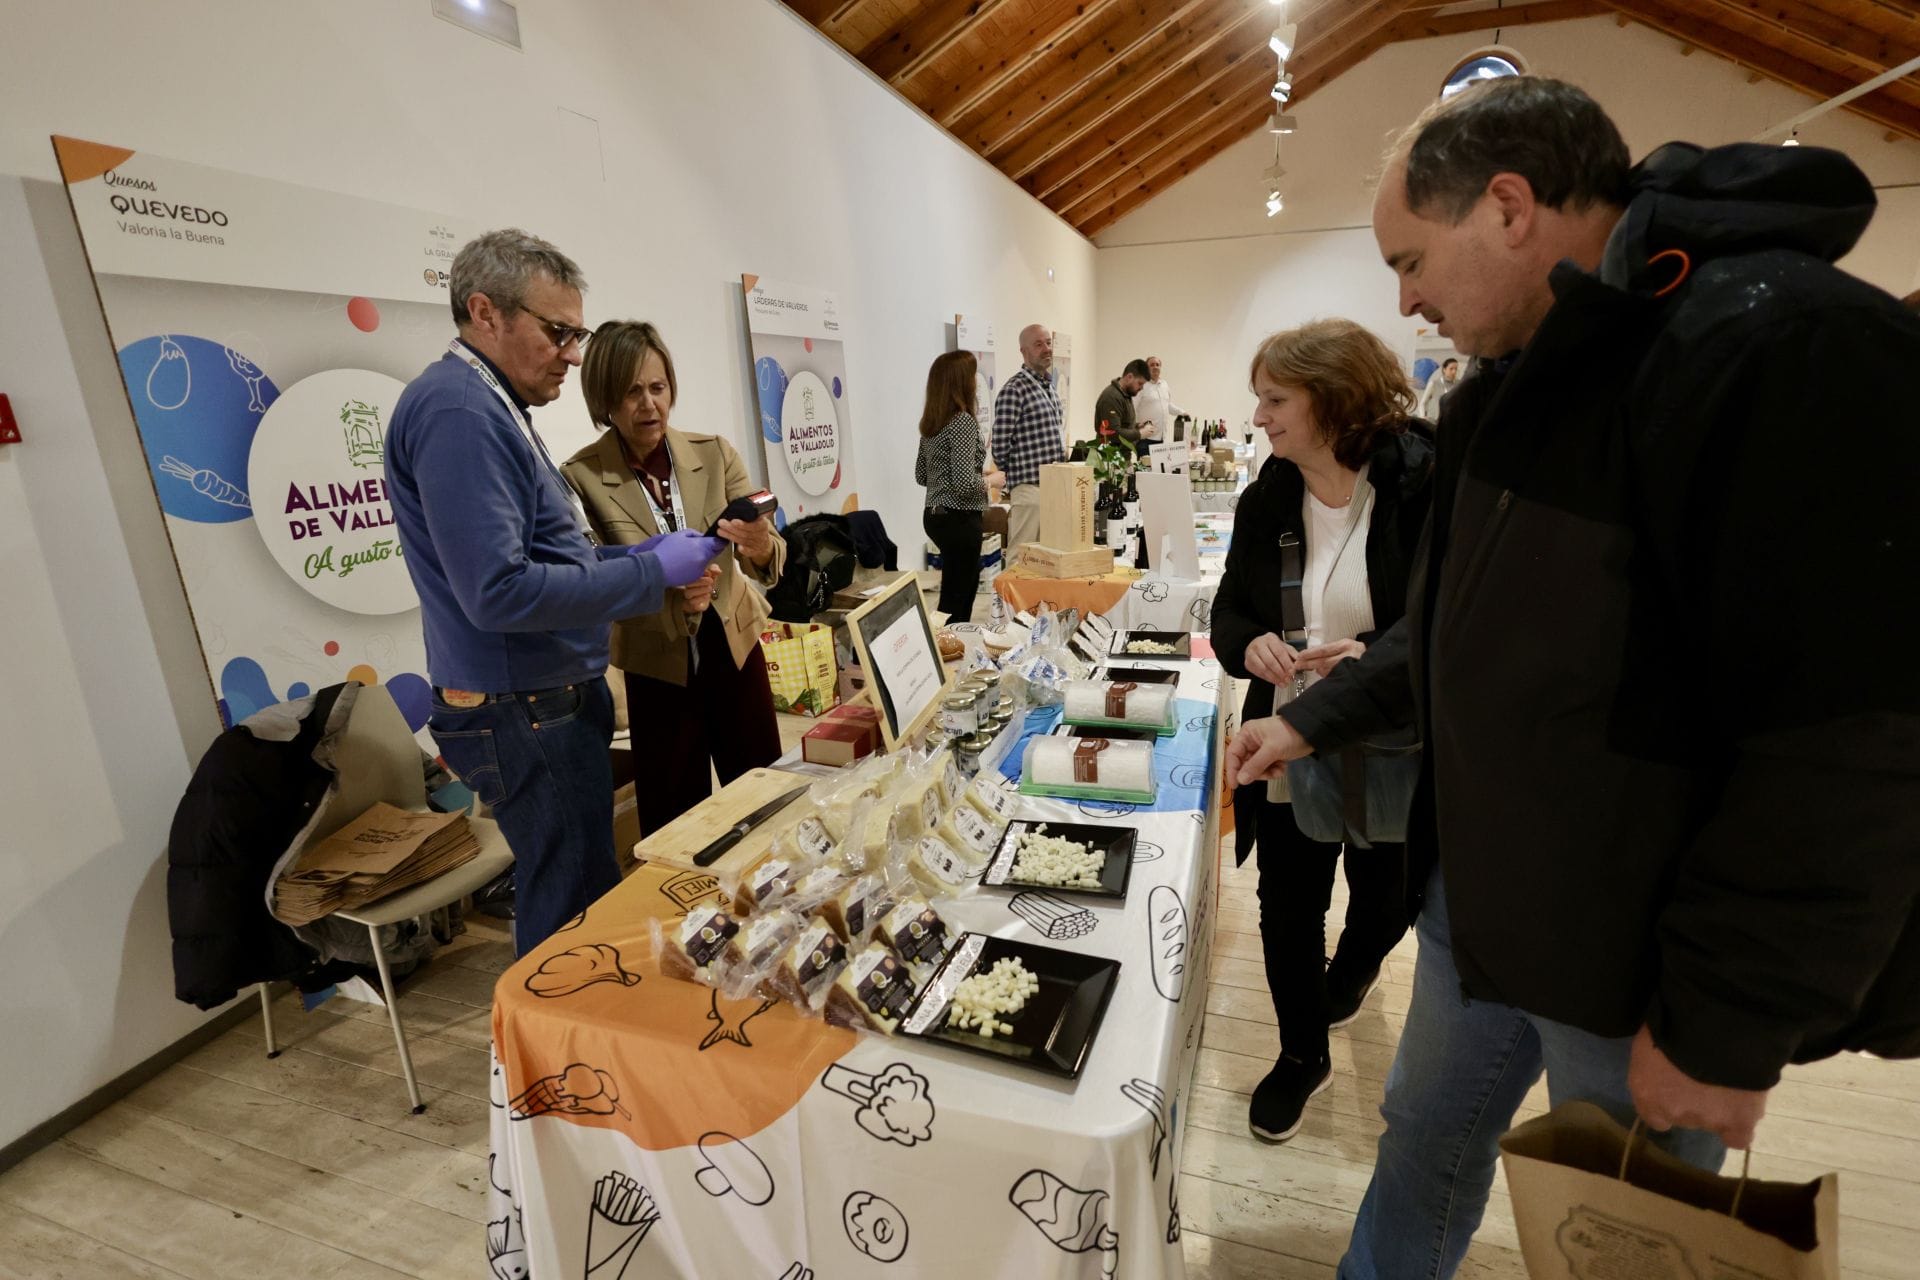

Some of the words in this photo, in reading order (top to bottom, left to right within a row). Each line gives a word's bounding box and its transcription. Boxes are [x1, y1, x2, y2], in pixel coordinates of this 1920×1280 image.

[103, 169, 157, 192] Quesos
[110, 194, 229, 227] QUEVEDO
[117, 220, 167, 238] Valoria
[170, 228, 182, 240] la
[185, 230, 225, 246] Buena
[789, 424, 833, 441] ALIMENTOS
[791, 443, 799, 454] DE
[800, 438, 835, 452] VALLADOLID
[289, 517, 322, 540] DE
[304, 545, 335, 579] A
[338, 539, 393, 578] gusto
[676, 878, 719, 896] MIEL
